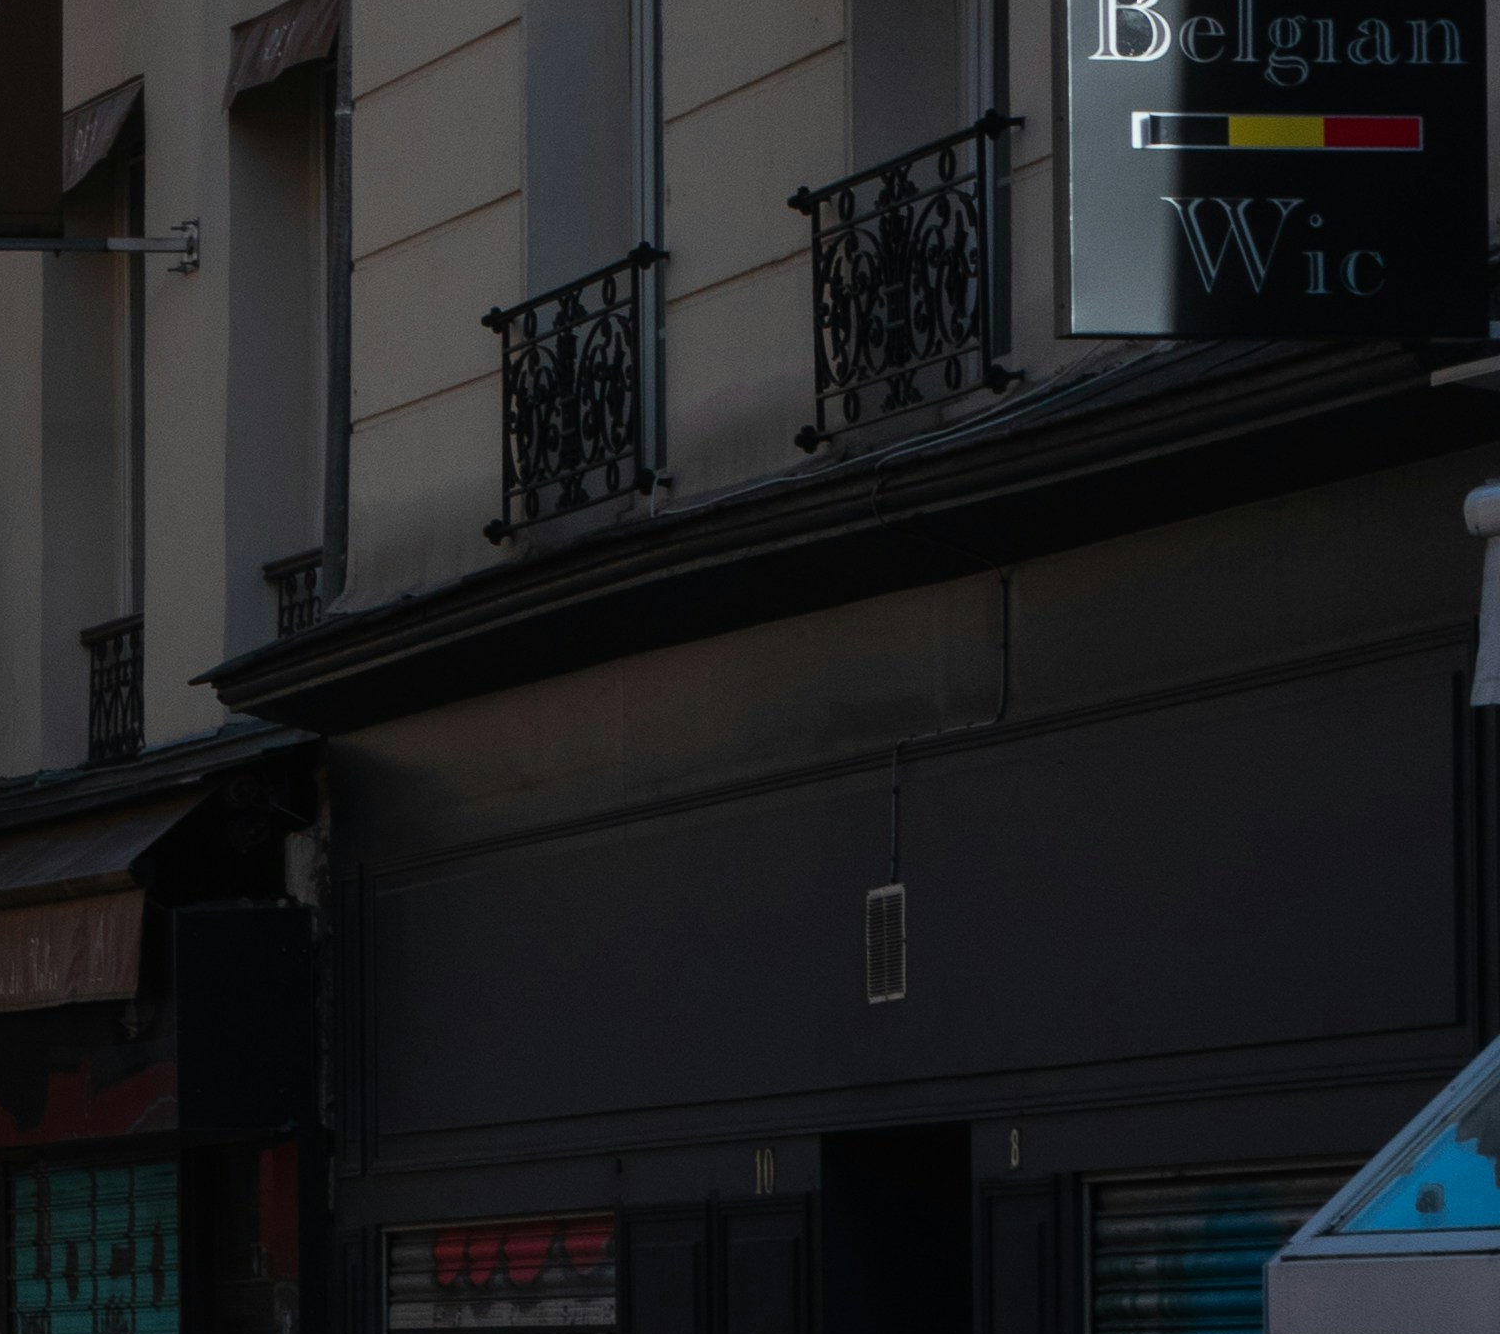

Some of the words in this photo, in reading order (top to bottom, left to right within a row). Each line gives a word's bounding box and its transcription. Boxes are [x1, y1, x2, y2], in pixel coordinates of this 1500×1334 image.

[1159, 196, 1387, 296] Wic
[755, 1148, 774, 1195] 10
[1010, 1128, 1020, 1168] 8
